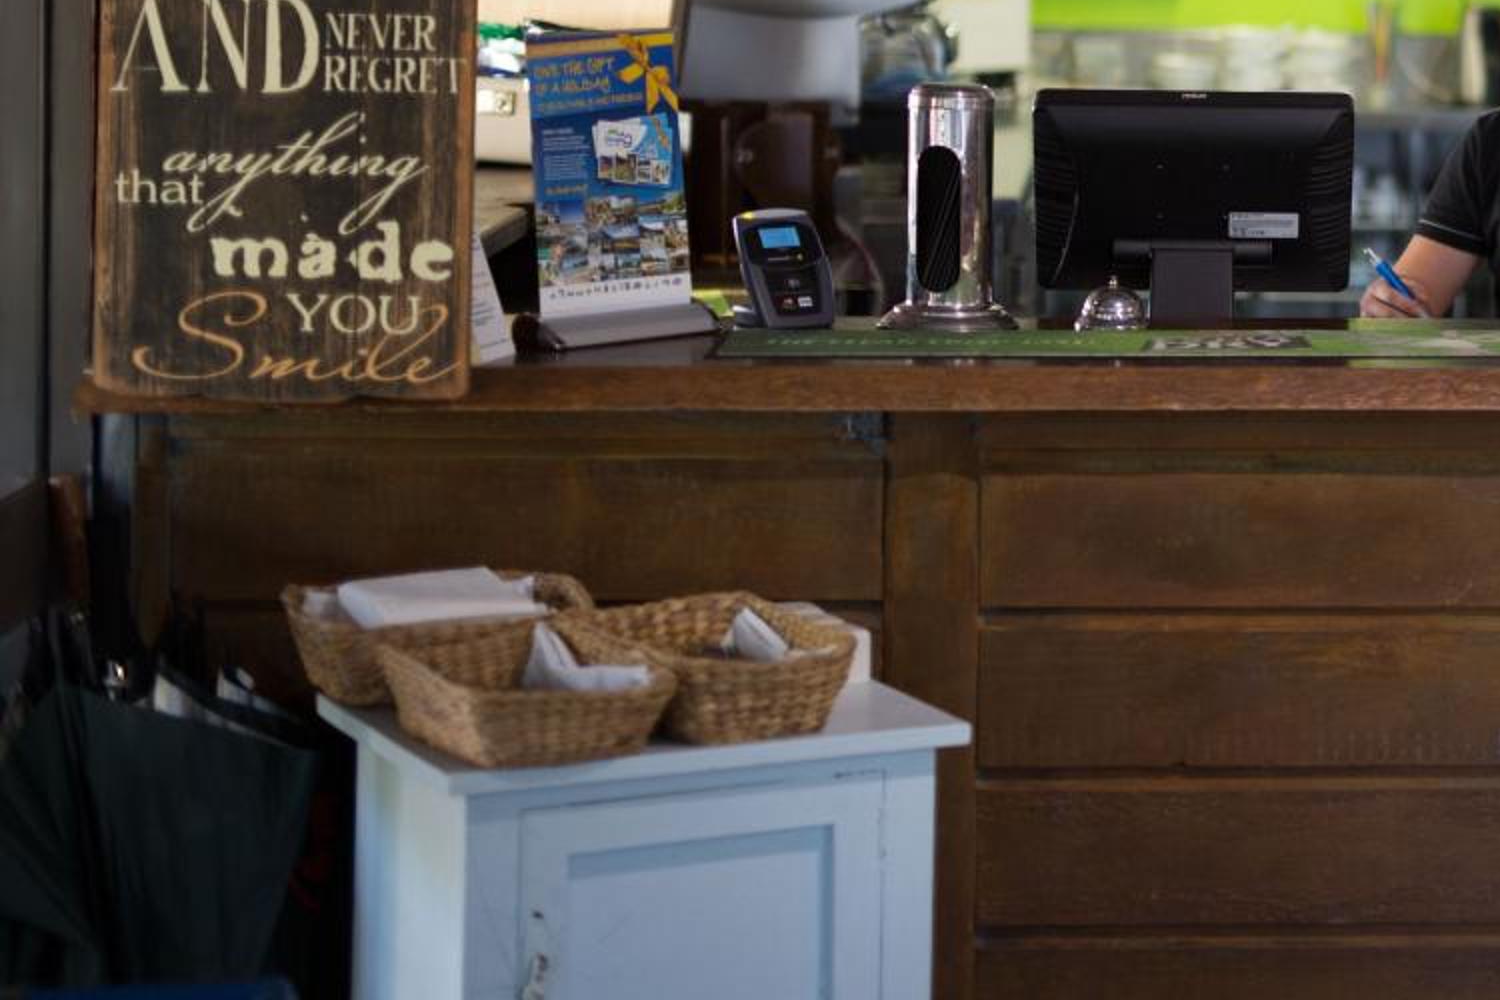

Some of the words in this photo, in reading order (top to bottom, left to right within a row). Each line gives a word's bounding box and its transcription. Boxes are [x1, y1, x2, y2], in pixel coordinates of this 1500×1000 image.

[325, 12, 436, 51] NEVER
[323, 57, 467, 94] REGRET
[115, 169, 204, 205] that
[162, 111, 430, 235] anything
[210, 221, 454, 283] made
[287, 294, 420, 334] YOU
[132, 291, 458, 383] Smile
